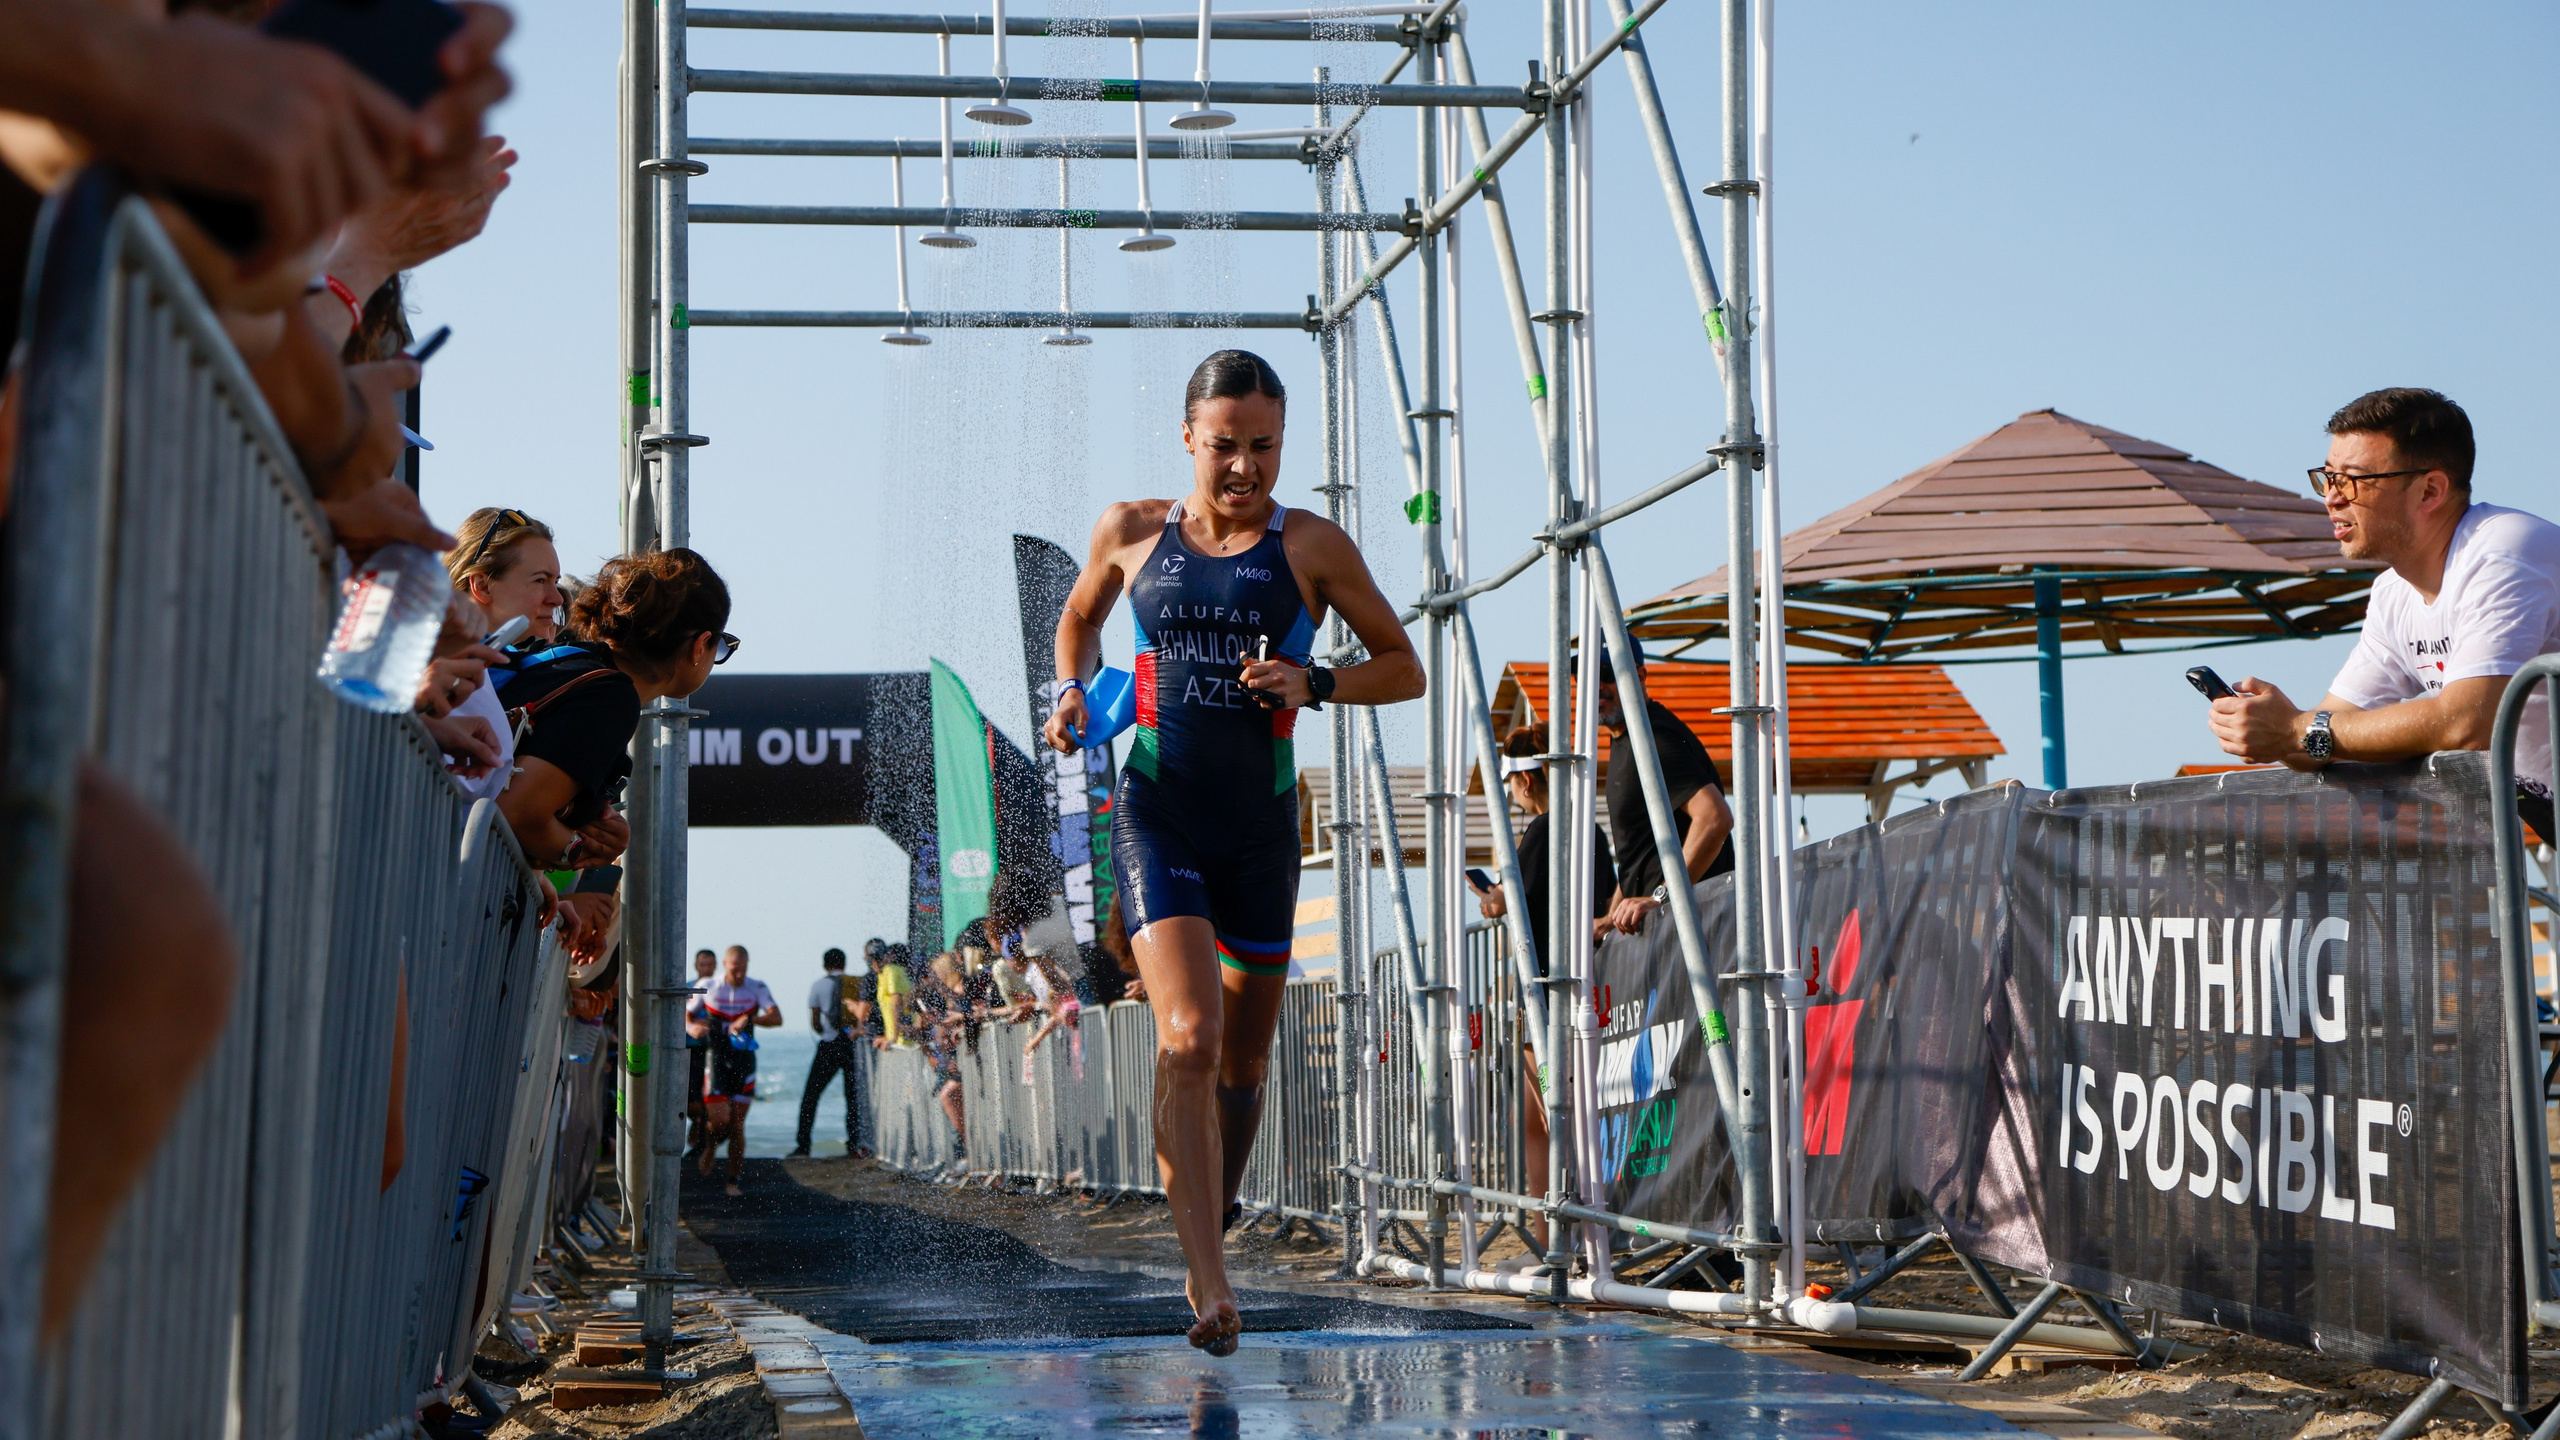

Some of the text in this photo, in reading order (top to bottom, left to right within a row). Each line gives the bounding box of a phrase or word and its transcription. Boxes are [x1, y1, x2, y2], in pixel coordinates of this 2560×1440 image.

[1155, 580, 1183, 588] Triathlon
[1235, 566, 1272, 582] MAKO
[1160, 604, 1262, 626] ALUFAR
[1182, 675, 1243, 709] AZE
[757, 728, 863, 766] OUT
[2058, 916, 2350, 1043] ANYTHING
[2059, 1063, 2103, 1175] IS
